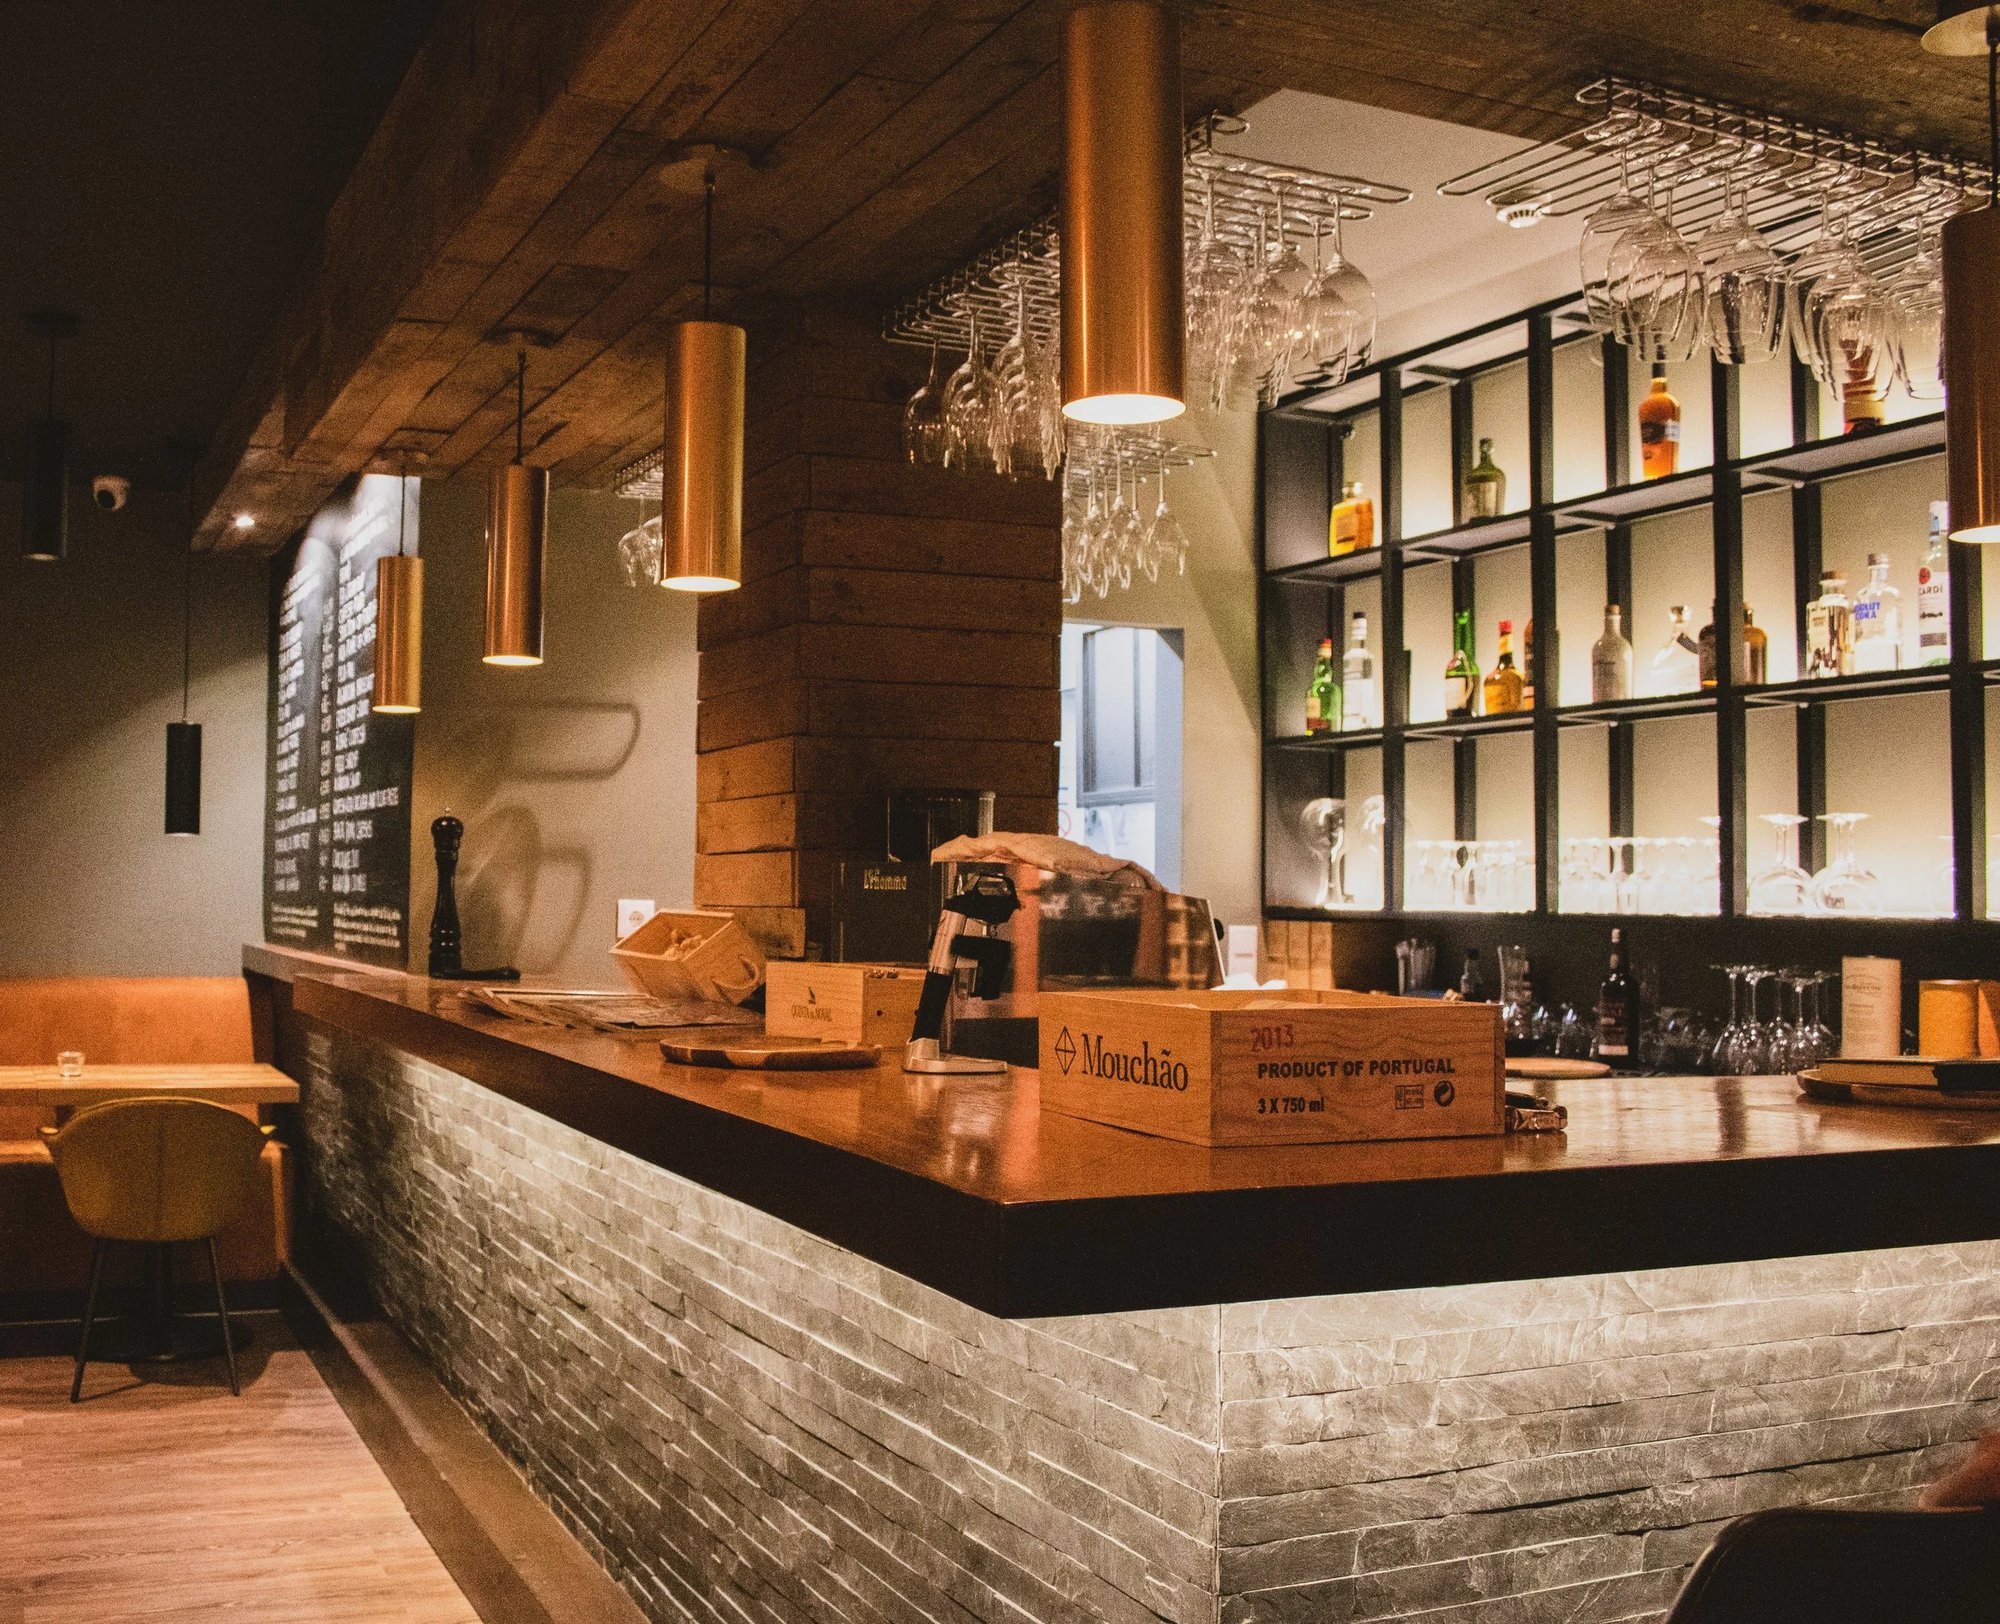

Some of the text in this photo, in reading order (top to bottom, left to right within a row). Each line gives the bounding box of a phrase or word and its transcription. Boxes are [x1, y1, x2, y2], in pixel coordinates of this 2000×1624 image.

[1251, 1024, 1295, 1053] 2013
[1082, 1033, 1189, 1092] Mouchão
[1258, 1058, 1455, 1079] PRODUCT OF PORTUGAL
[1258, 1098, 1266, 1114] 3
[1282, 1096, 1305, 1114] 750
[1308, 1096, 1324, 1112] ml
